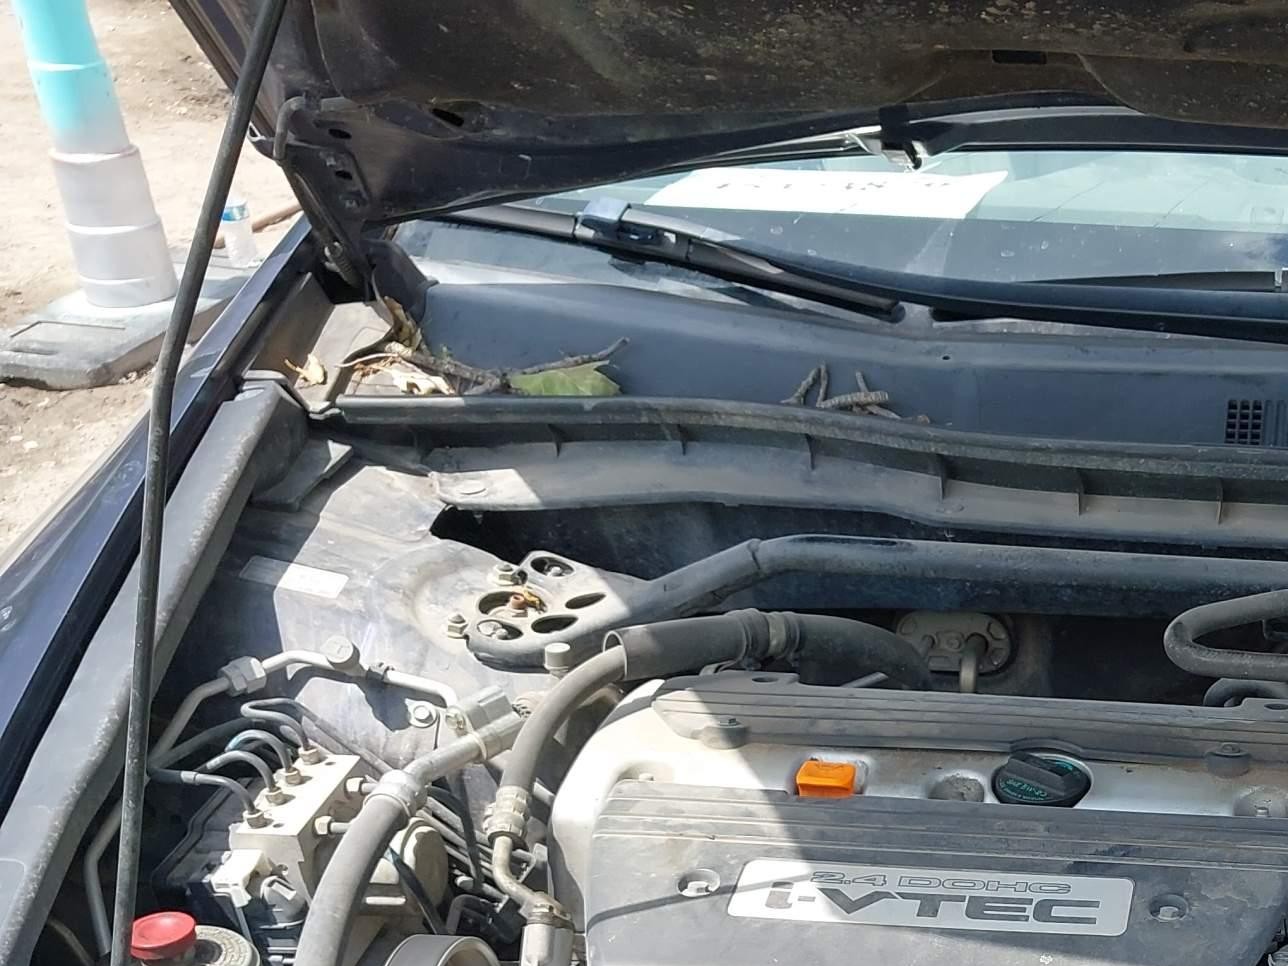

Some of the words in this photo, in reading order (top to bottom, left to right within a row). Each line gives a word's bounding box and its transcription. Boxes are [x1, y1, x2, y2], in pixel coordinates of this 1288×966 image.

[810, 871, 887, 887] 2.4
[897, 876, 1072, 895] DOHC
[765, 881, 1100, 925] i-VTEC
